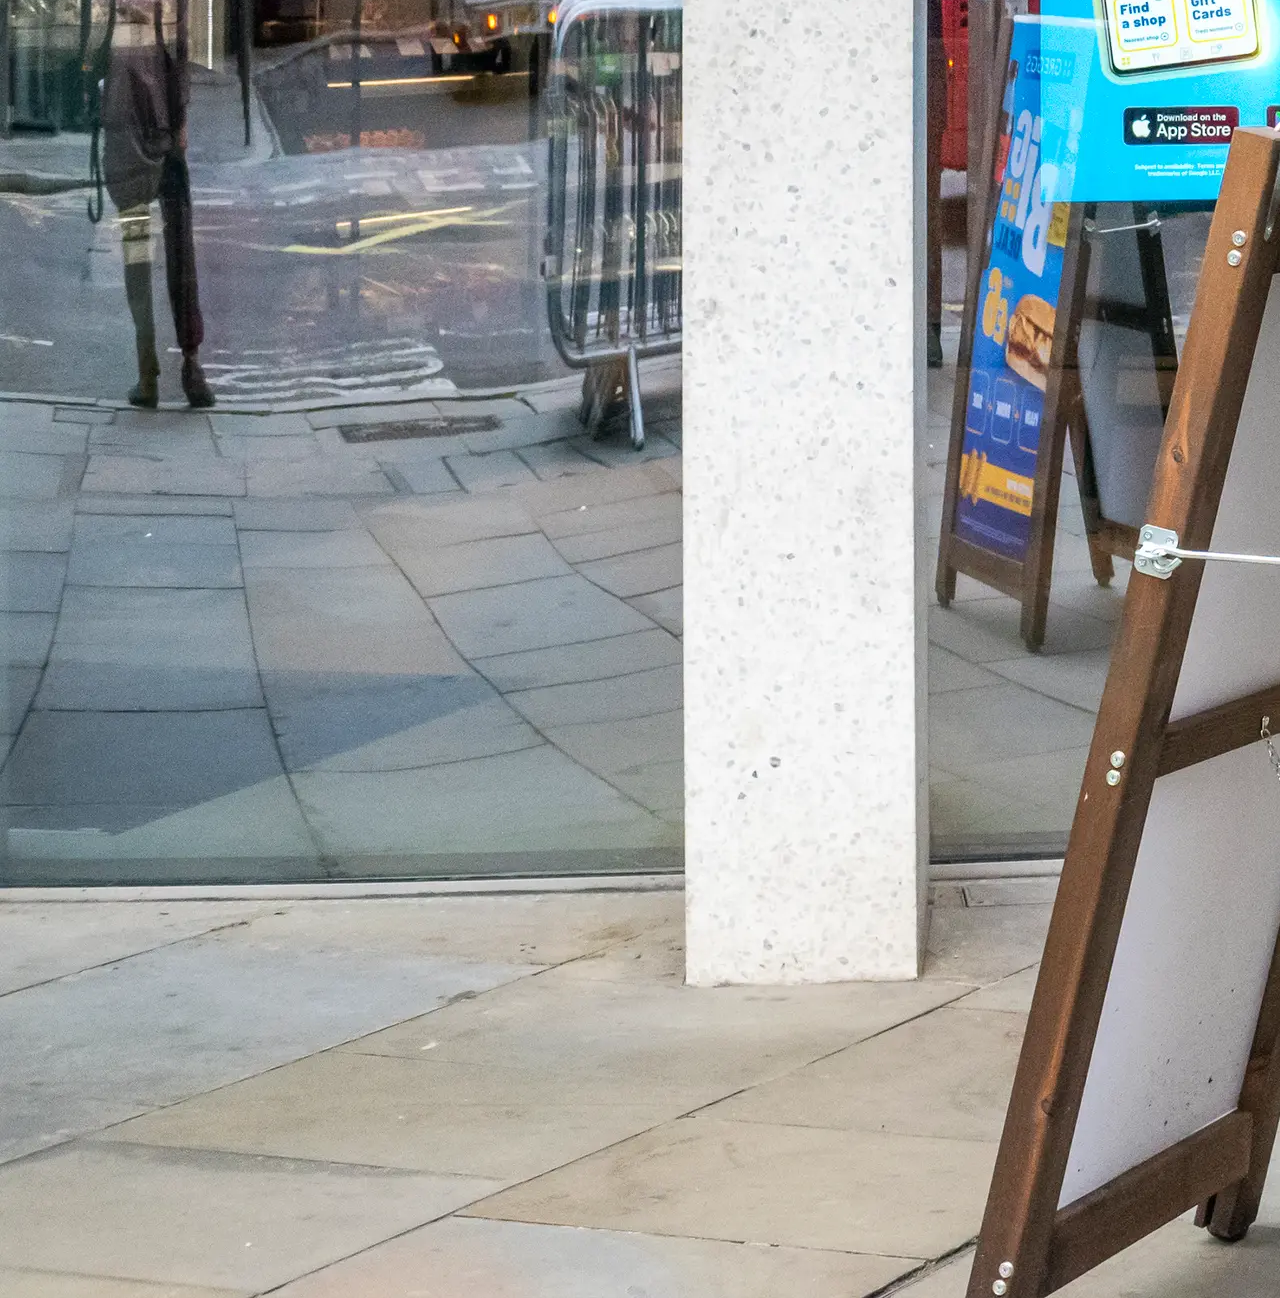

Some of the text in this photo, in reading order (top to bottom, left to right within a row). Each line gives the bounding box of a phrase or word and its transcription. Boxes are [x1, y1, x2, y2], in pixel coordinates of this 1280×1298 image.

[1120, 1, 1150, 15] Find
[1192, 6, 1232, 20] Cards
[1122, 15, 1167, 29] a shop
[1156, 113, 1227, 122] Download on the
[1156, 123, 1232, 139] App Store
